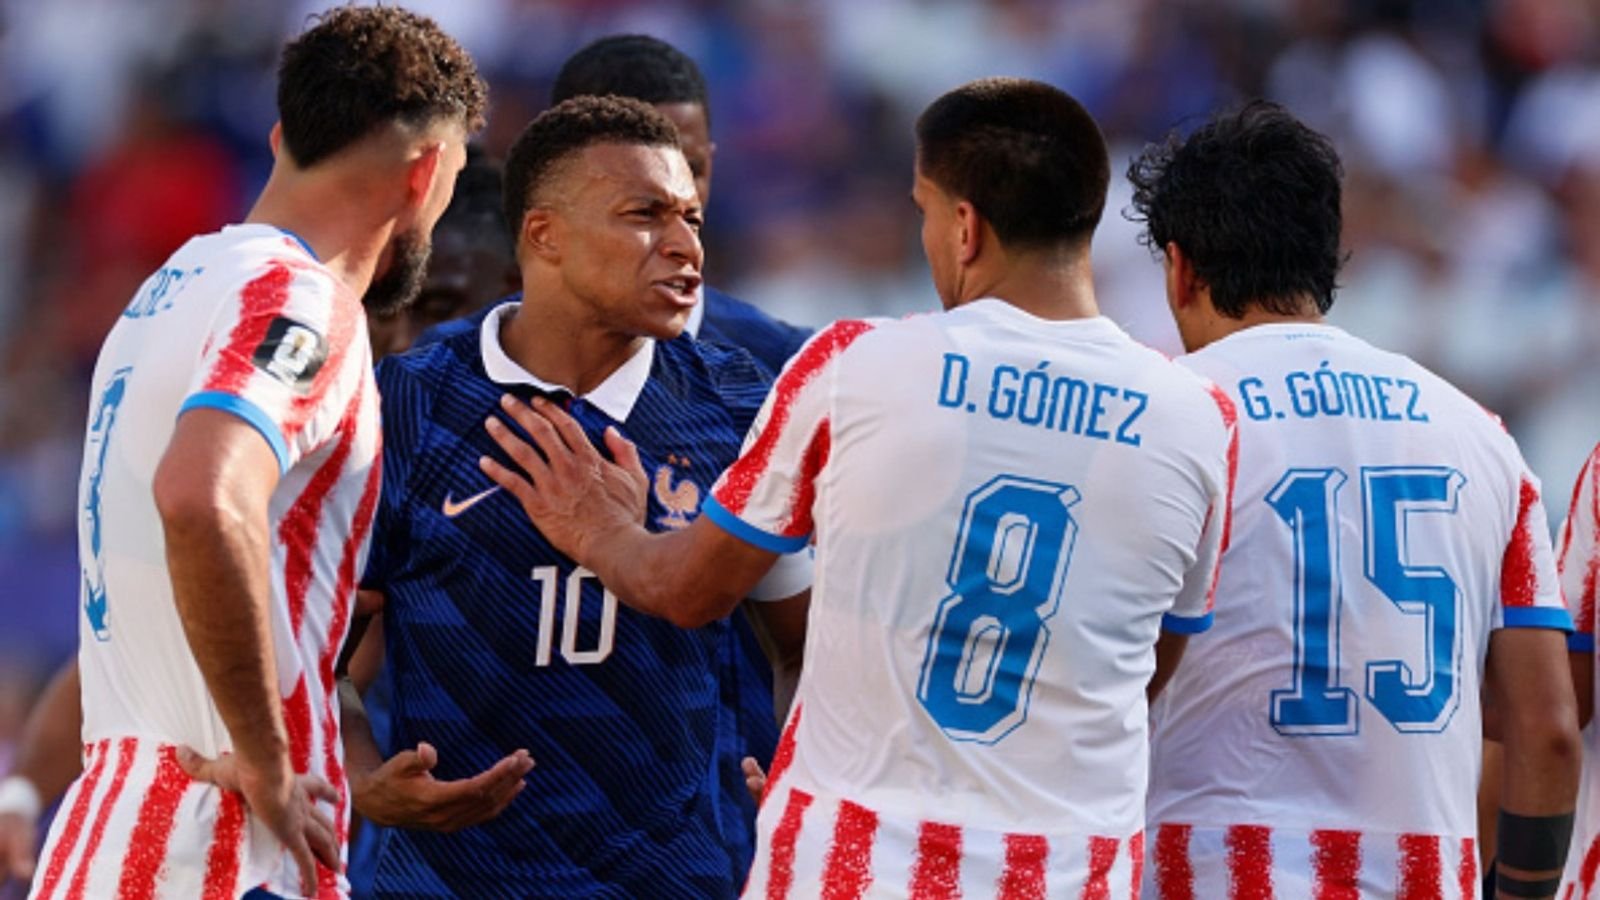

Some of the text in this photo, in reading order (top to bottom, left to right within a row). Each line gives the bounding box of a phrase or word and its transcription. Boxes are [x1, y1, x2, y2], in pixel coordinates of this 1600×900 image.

[987, 359, 1150, 448] GÓMEZ
[531, 565, 619, 667] 10
[915, 473, 1083, 747] 8
[1263, 464, 1468, 738] 15
